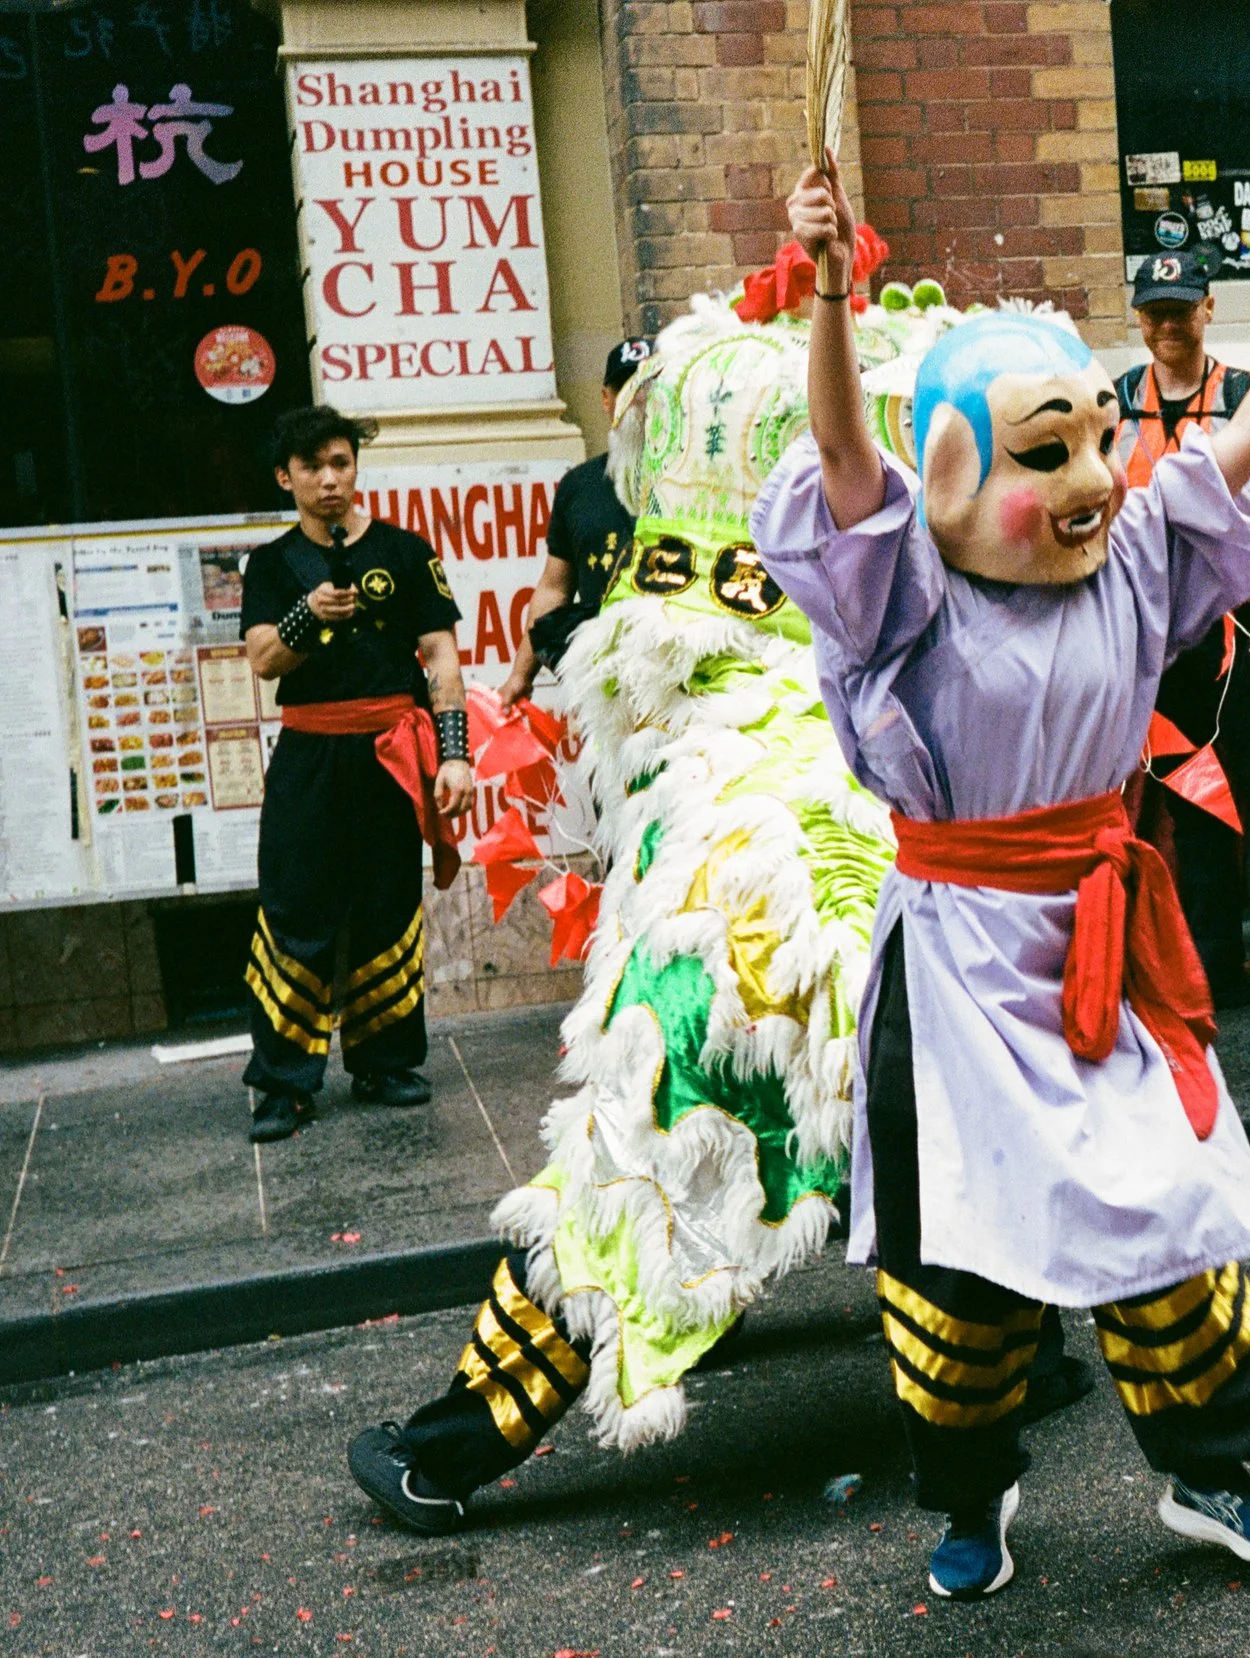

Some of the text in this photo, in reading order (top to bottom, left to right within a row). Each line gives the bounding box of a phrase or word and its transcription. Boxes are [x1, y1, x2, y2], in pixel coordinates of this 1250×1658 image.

[297, 70, 523, 112] Shanghai
[83, 83, 243, 186] 杭
[303, 115, 532, 158] Dumpling
[343, 159, 500, 188] HOUSE
[313, 194, 540, 254] YUM
[96, 248, 262, 302] B.Y.O
[321, 258, 538, 318] CHA
[321, 336, 554, 381] SPECIAL
[352, 482, 560, 562] HANGHA
